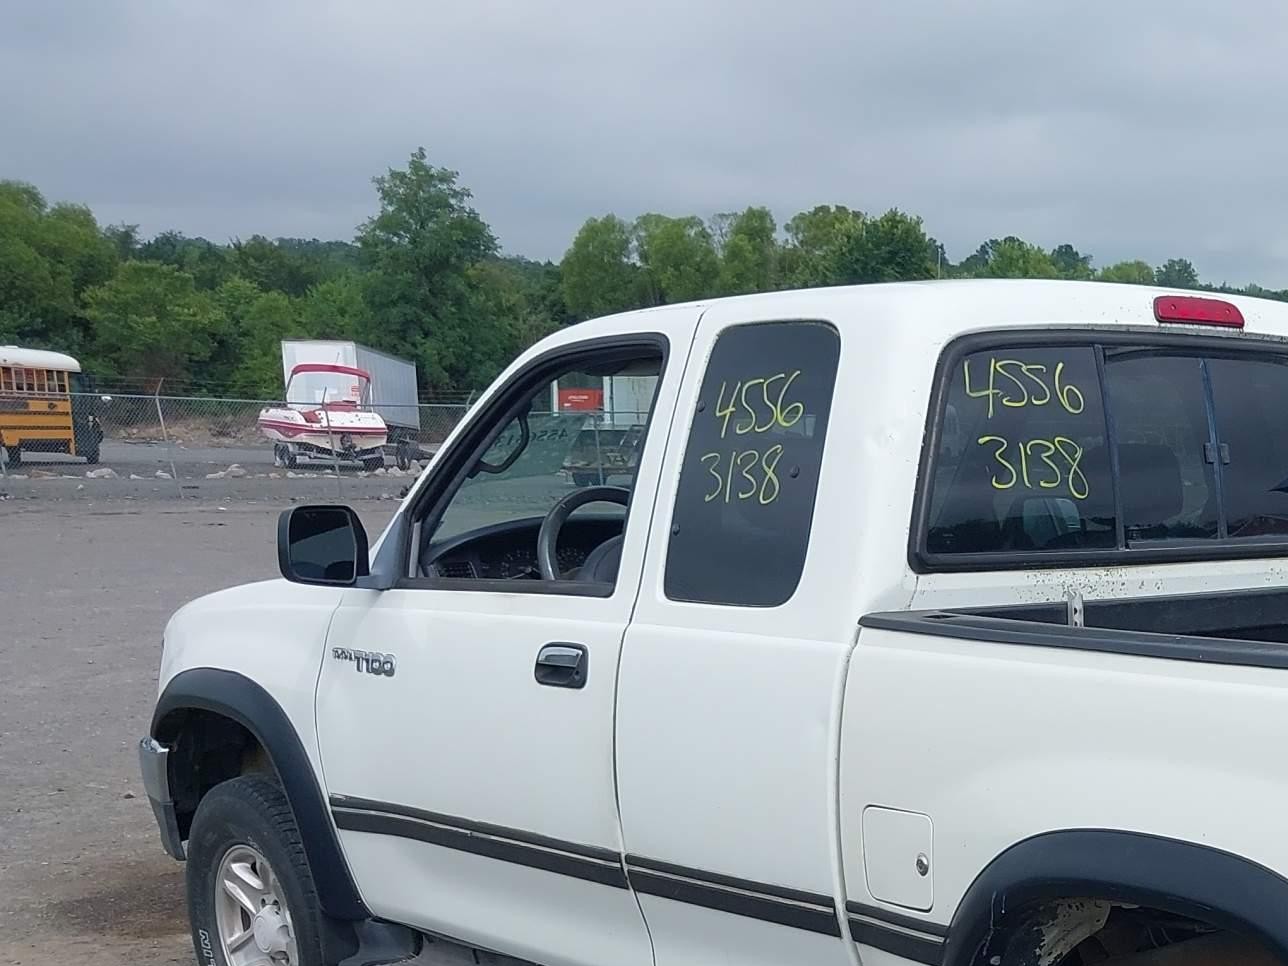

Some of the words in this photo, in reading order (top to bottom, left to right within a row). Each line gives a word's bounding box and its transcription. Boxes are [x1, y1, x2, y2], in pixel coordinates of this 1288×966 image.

[715, 370, 804, 439] 4556
[963, 357, 1084, 419] 4556
[700, 444, 785, 505] 3138
[977, 436, 1090, 500] 3138
